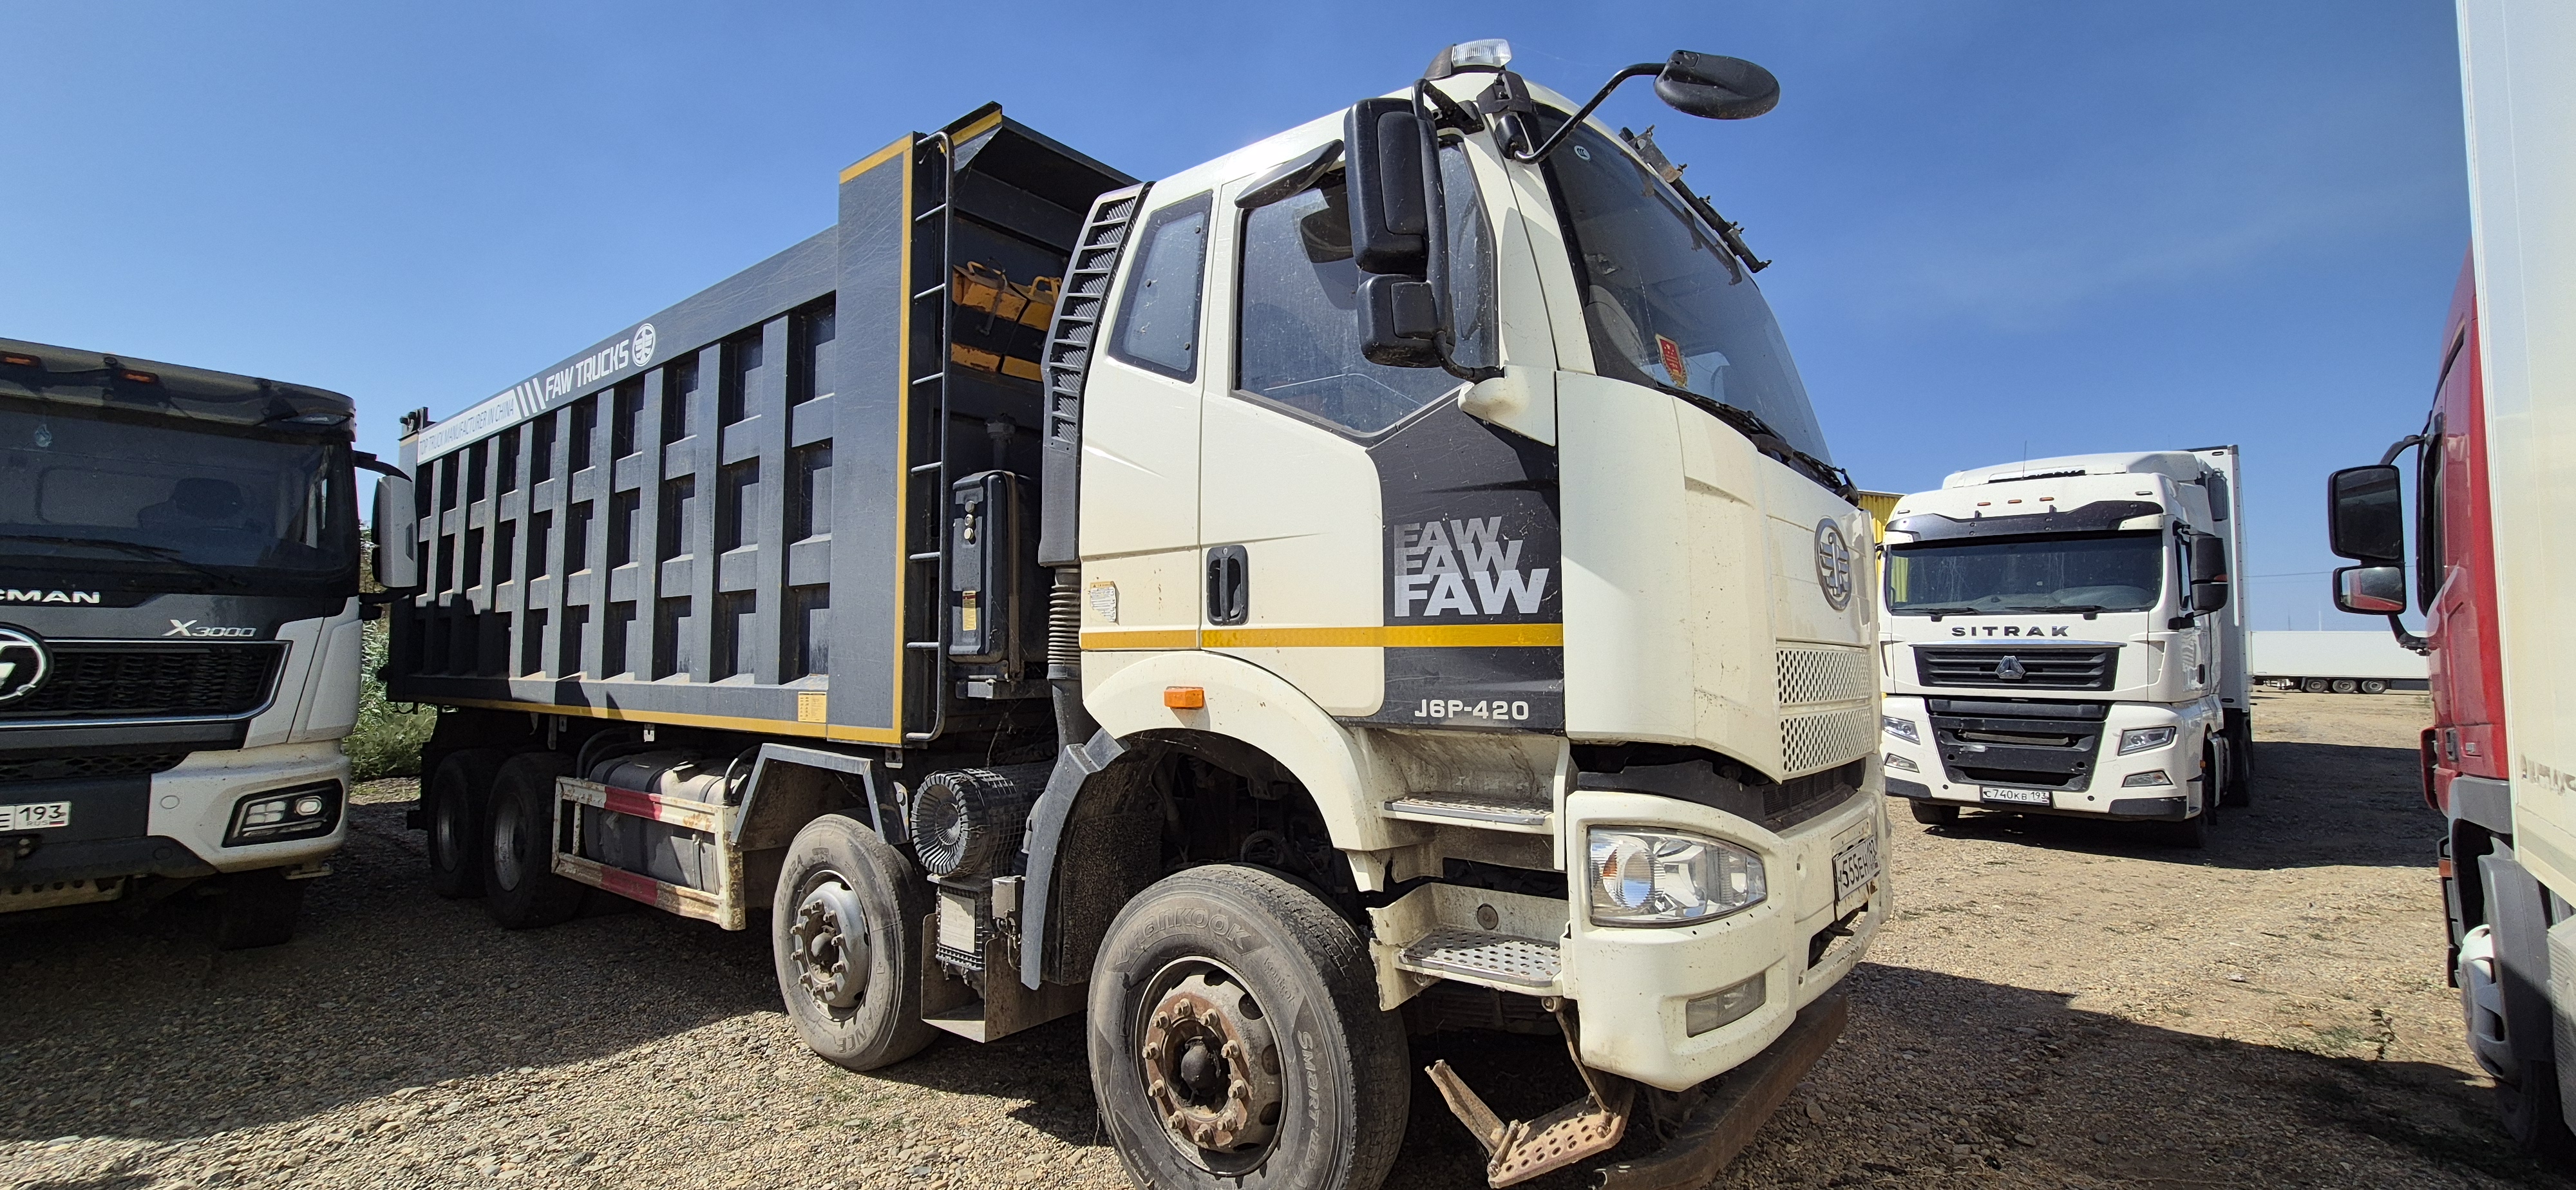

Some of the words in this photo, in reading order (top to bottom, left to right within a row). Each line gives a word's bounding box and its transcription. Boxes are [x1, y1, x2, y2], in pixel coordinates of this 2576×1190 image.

[545, 365, 574, 402] FAW
[576, 339, 629, 388] TRUCKS
[487, 407, 495, 426] IN
[495, 398, 514, 422] CHINA
[1394, 516, 1502, 551] FAW
[1394, 540, 1524, 580] FAW
[1394, 568, 1549, 617] FAW
[161, 619, 257, 637] X3000
[1951, 625, 2069, 637] SITRAK
[1414, 699, 1529, 720] J6P-420
[2030, 791, 2047, 800] 193
[19, 805, 62, 822] 193
